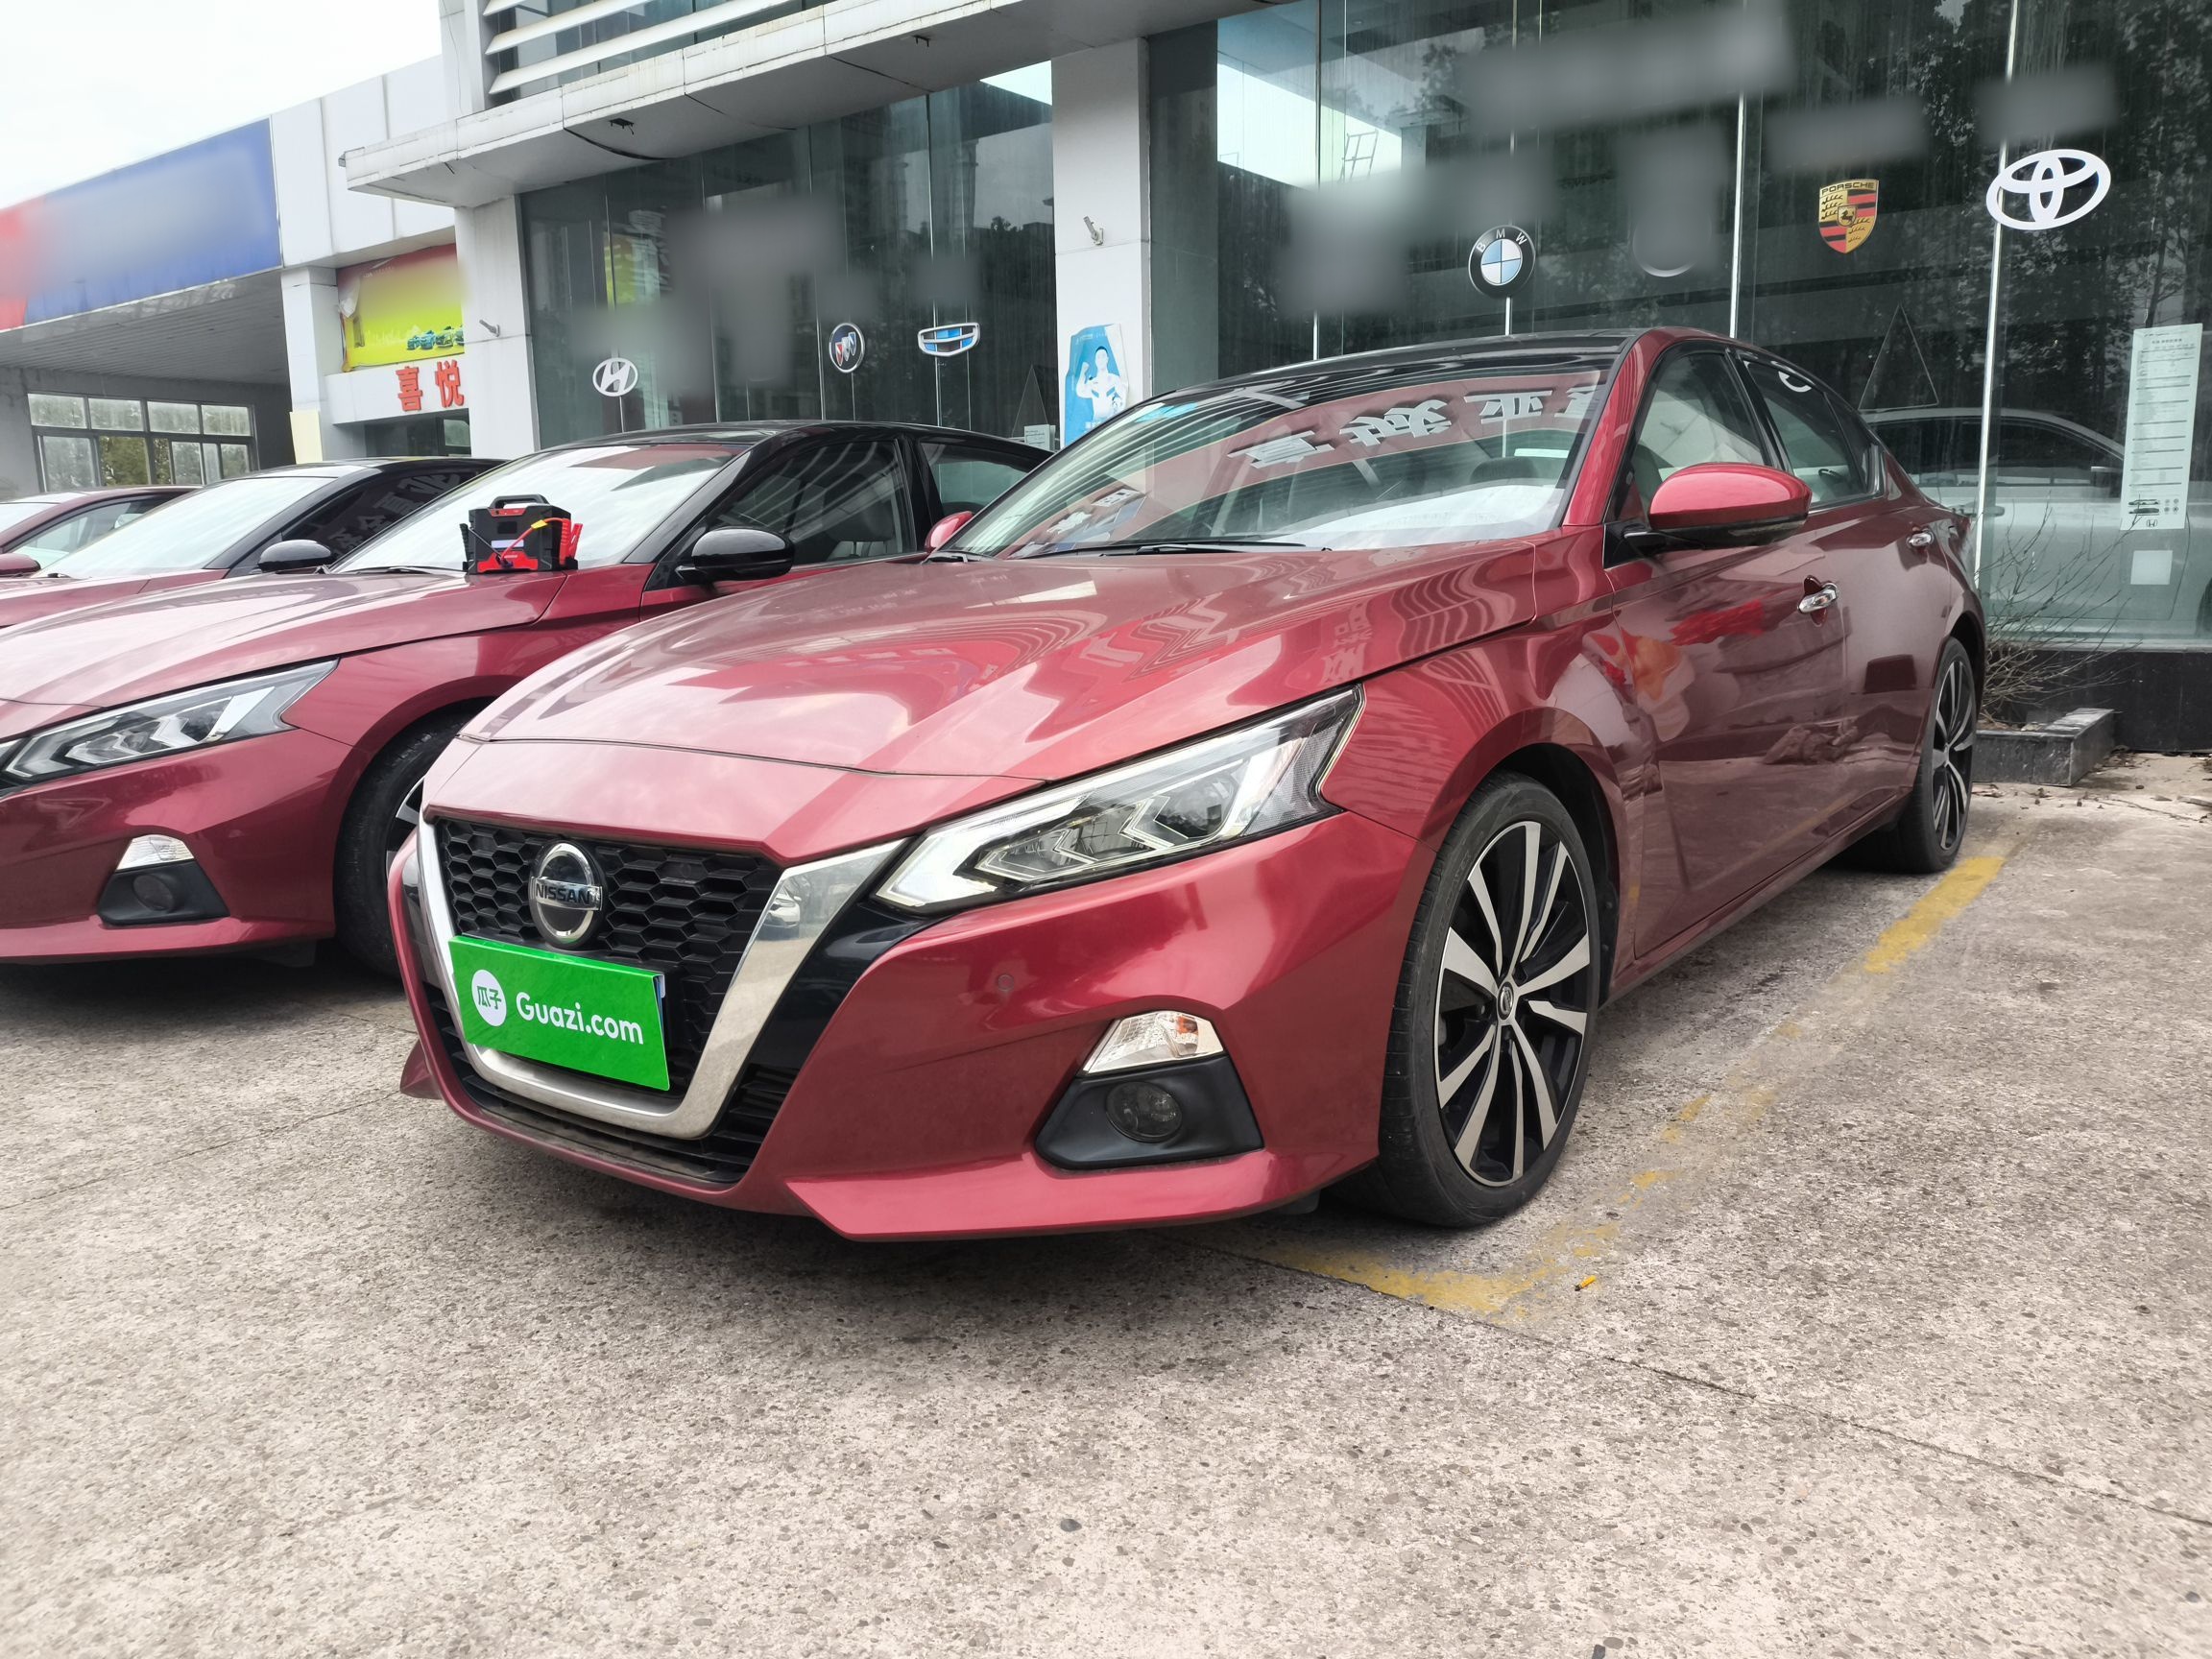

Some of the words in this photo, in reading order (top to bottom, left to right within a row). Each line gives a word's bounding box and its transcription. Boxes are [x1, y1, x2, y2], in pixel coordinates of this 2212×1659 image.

[1820, 181, 1875, 196] PORSCHE
[1476, 228, 1528, 252] BMW
[395, 358, 465, 413] 喜悦
[536, 881, 591, 906] NISSAN
[476, 985, 502, 1010] 瓜子
[516, 991, 644, 1045] Guazi.com
